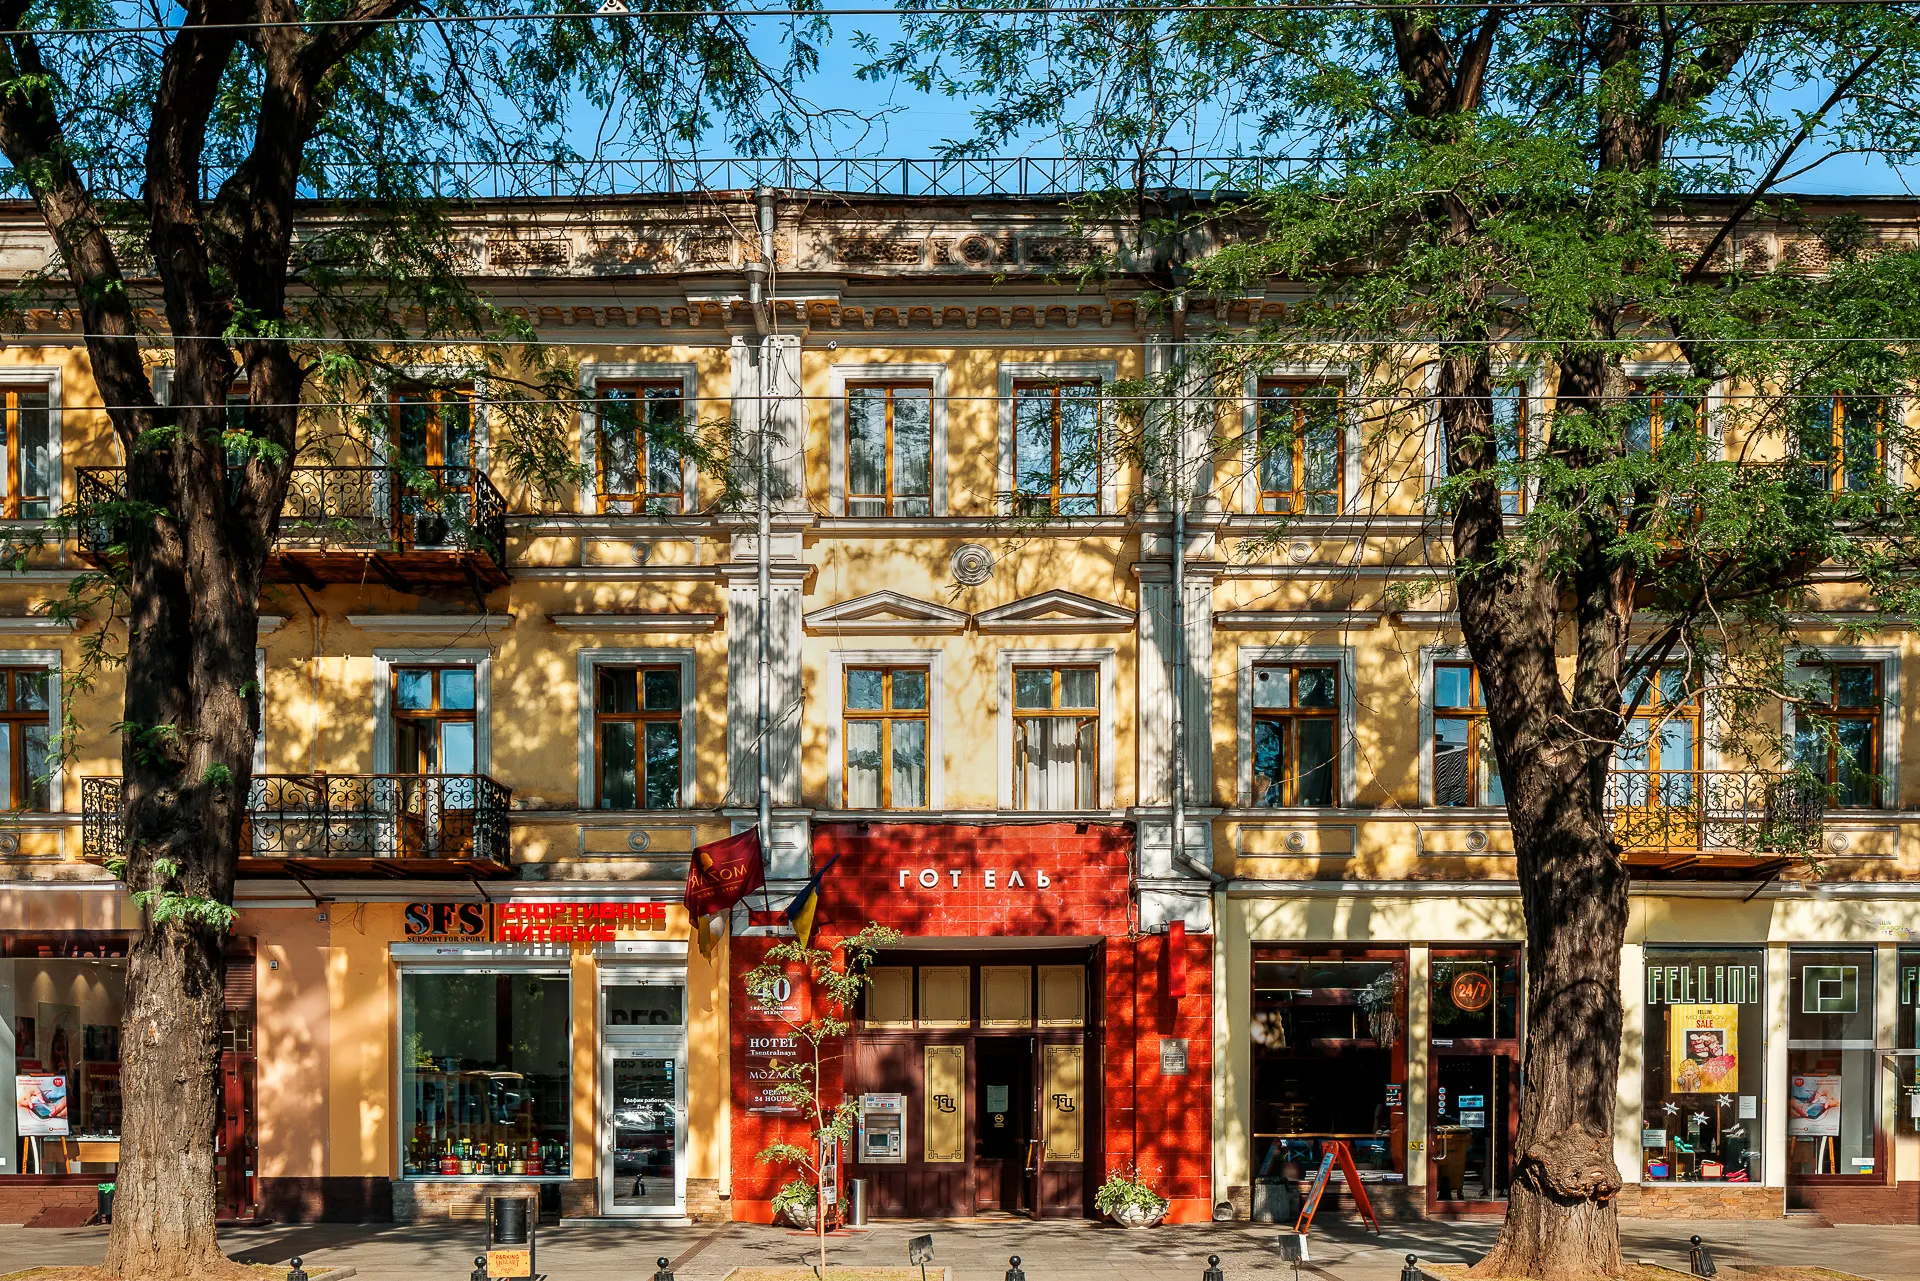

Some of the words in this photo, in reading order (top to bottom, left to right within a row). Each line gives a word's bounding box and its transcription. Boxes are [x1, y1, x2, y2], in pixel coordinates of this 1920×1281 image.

[899, 868, 1050, 888] ГОТЕЛЬ
[405, 903, 485, 935] SFS
[500, 903, 666, 919] СПОРТИВНОЕ
[500, 926, 615, 942] ПИТАНИЕ
[1459, 982, 1486, 999] 24/7
[1696, 1020, 1714, 1028] SALE
[750, 1038, 797, 1048] HOTEL
